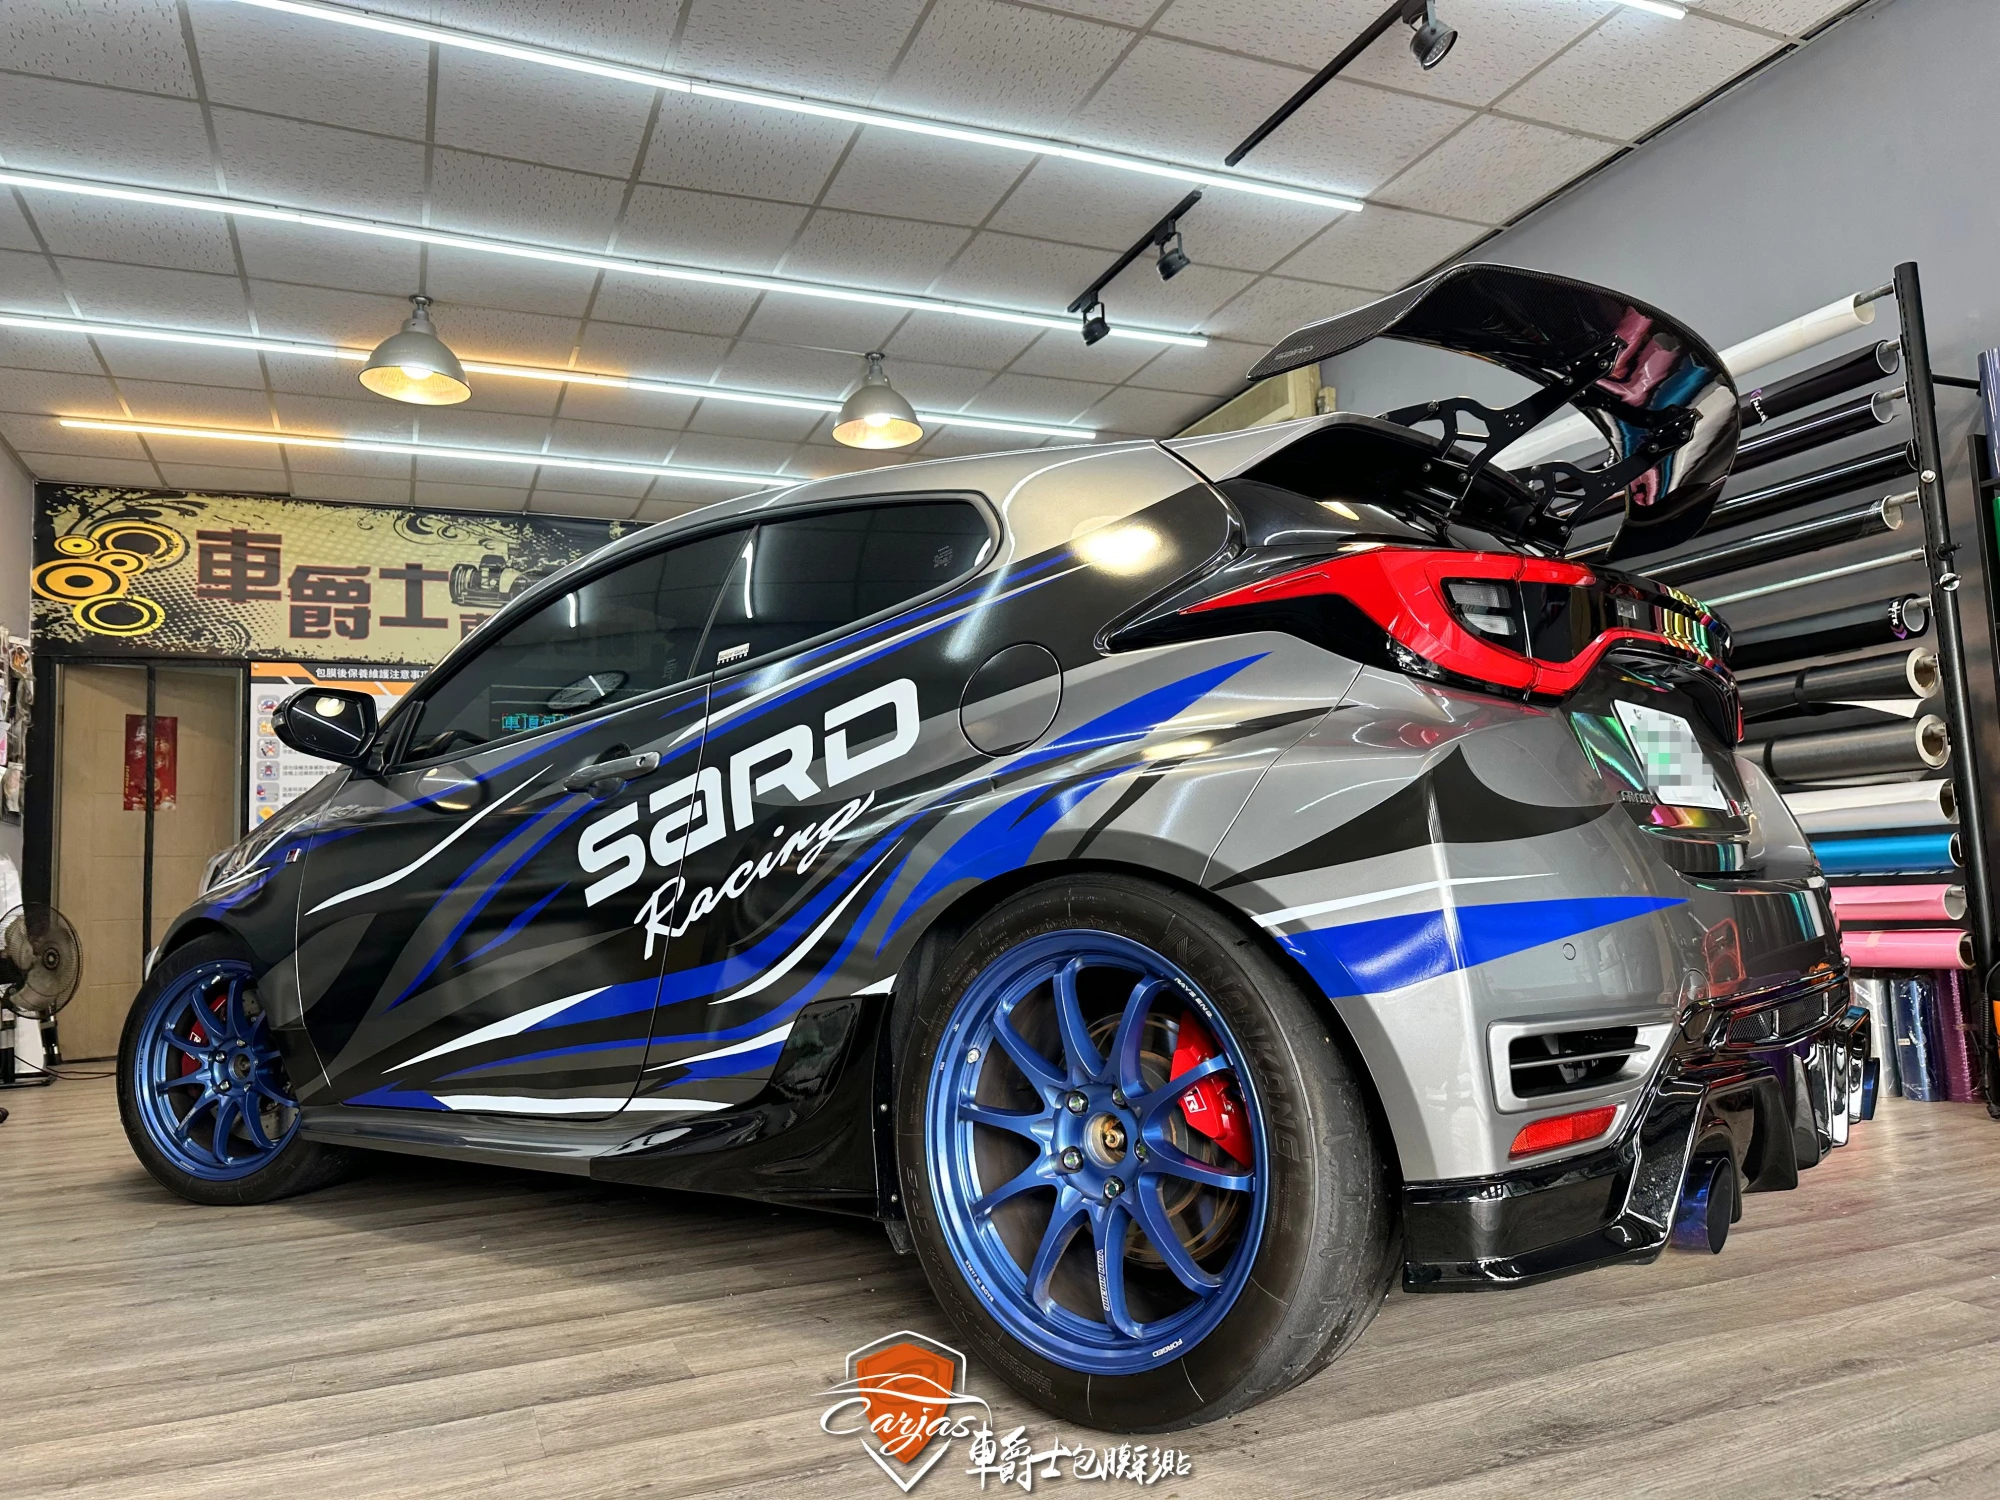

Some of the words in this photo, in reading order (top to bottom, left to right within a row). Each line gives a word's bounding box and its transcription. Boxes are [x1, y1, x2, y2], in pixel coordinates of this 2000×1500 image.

[634, 789, 876, 960] Racing
[1202, 965, 1302, 1163] NANKANG
[1152, 1338, 1183, 1358] FORGED
